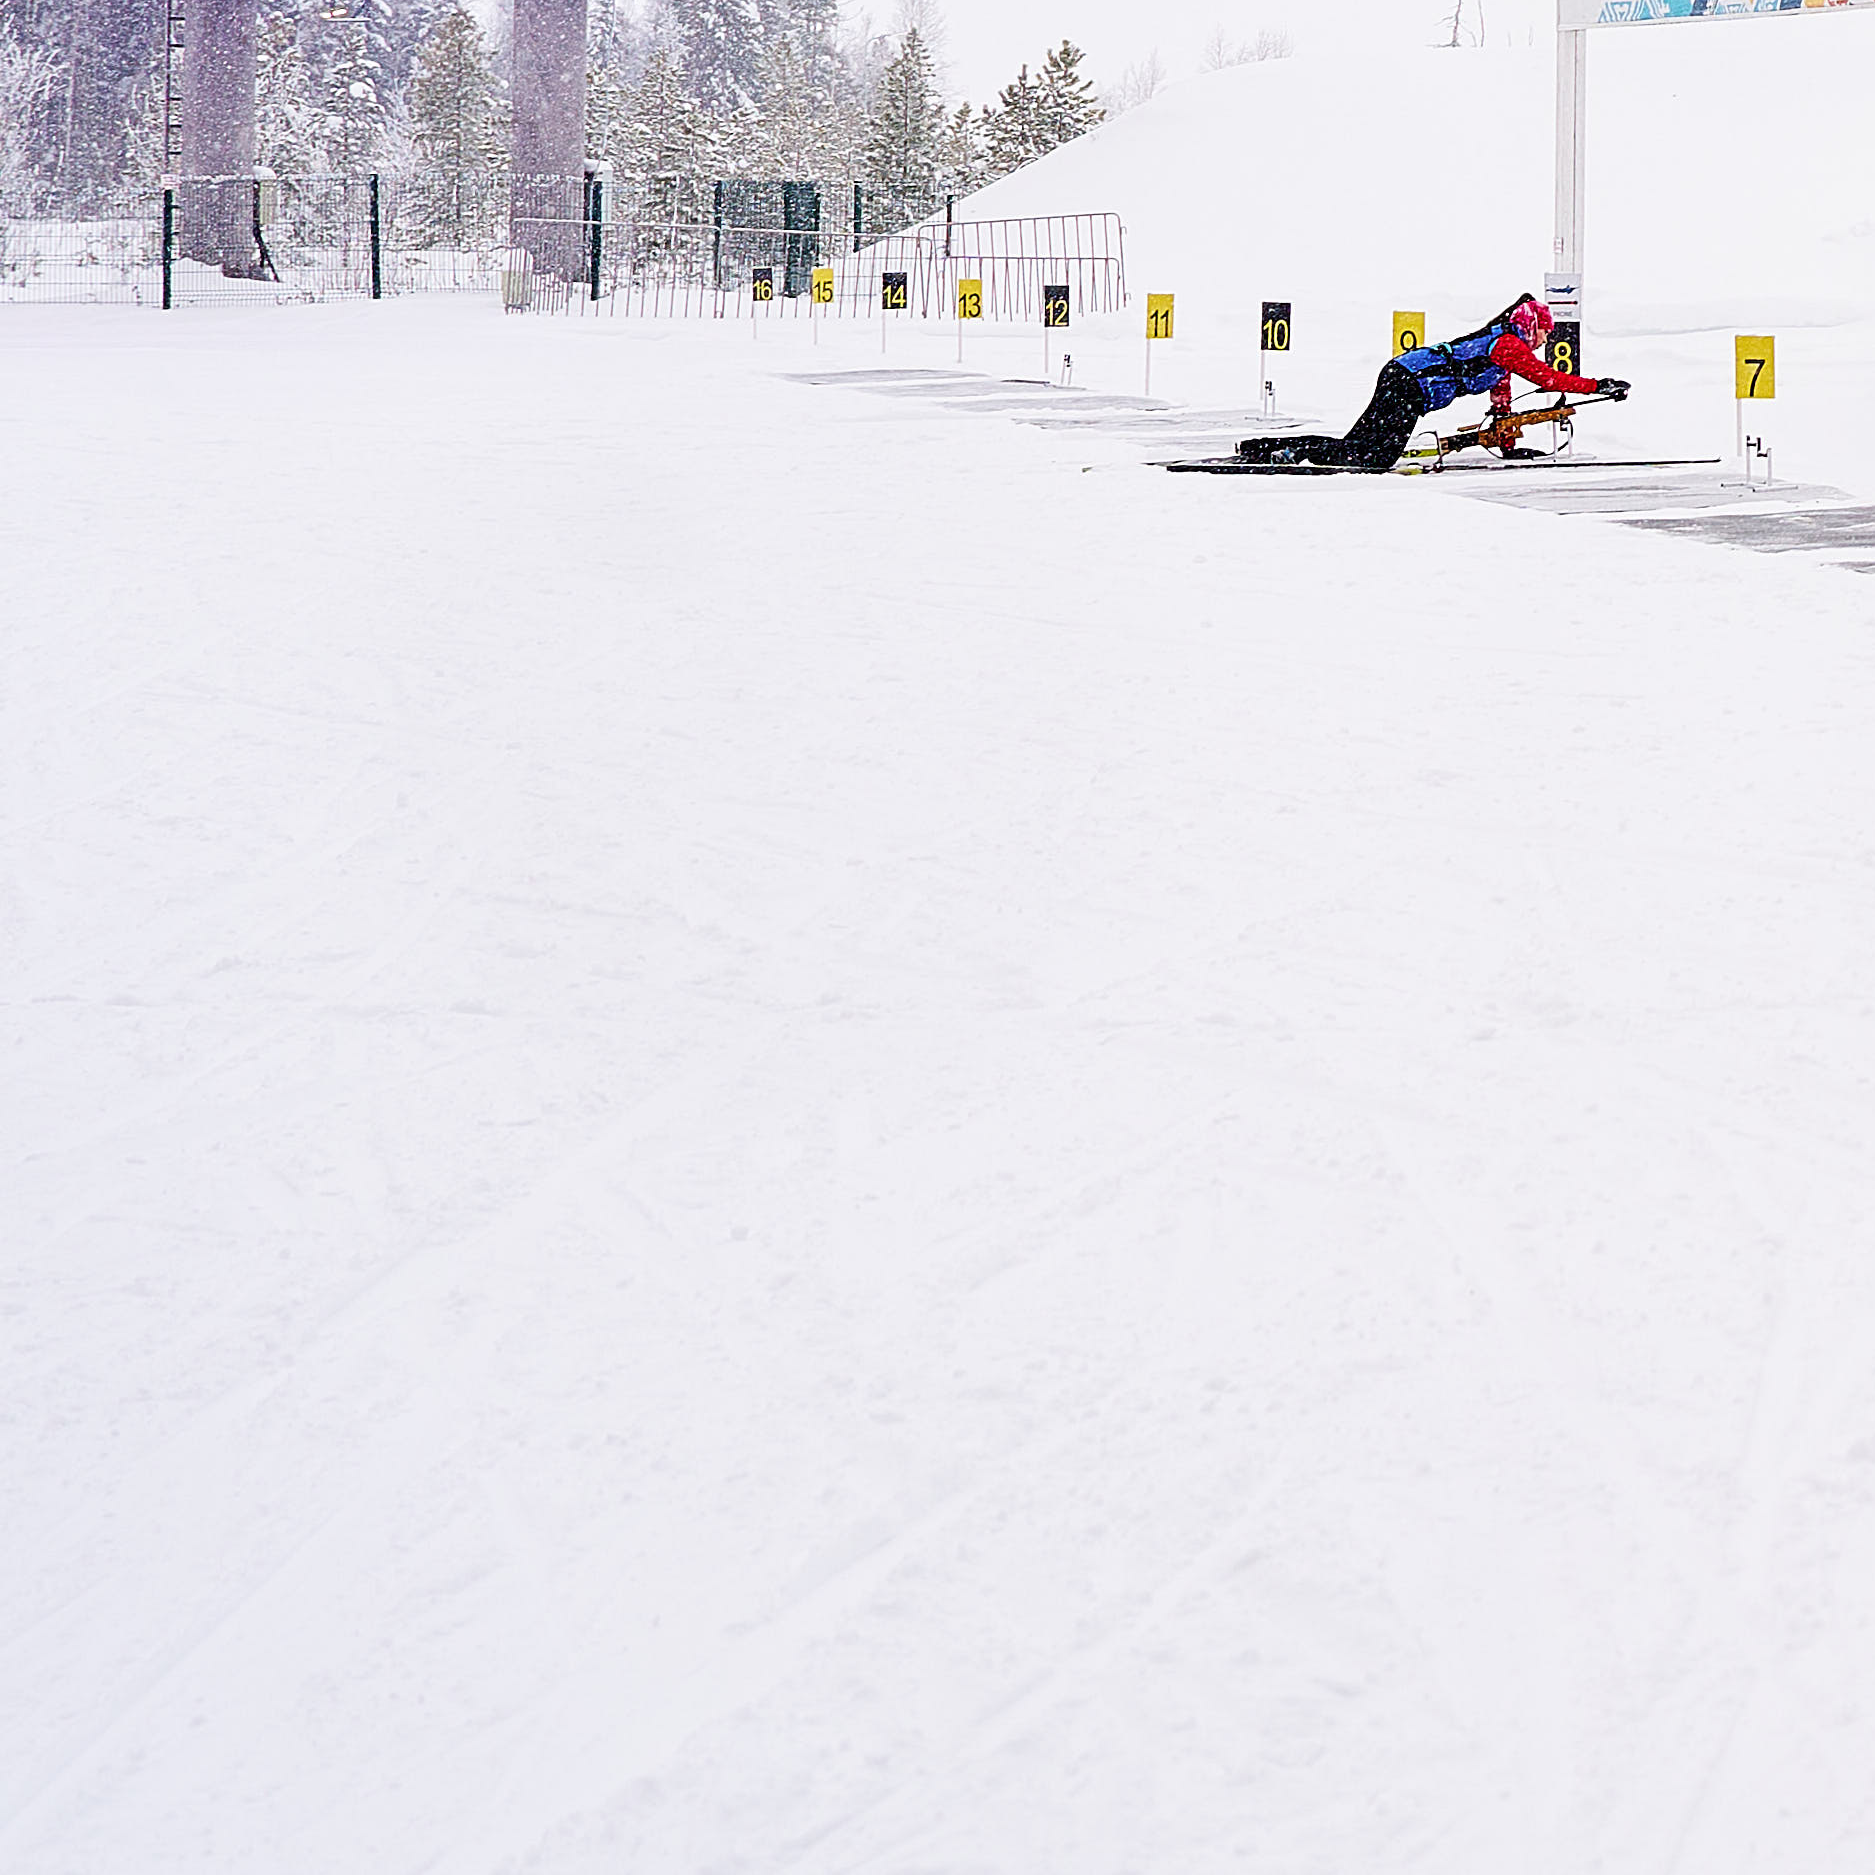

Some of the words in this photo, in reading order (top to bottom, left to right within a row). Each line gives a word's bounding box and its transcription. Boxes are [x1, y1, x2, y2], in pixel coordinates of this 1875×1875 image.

[754, 280, 771, 300] 16
[813, 280, 833, 303] 15
[883, 285, 906, 308] 14
[959, 293, 981, 318] 13
[1045, 300, 1069, 326] 12
[1149, 309, 1170, 338] 11
[1263, 319, 1289, 350] 10
[1553, 341, 1573, 375] 8
[1743, 358, 1766, 398] 7
